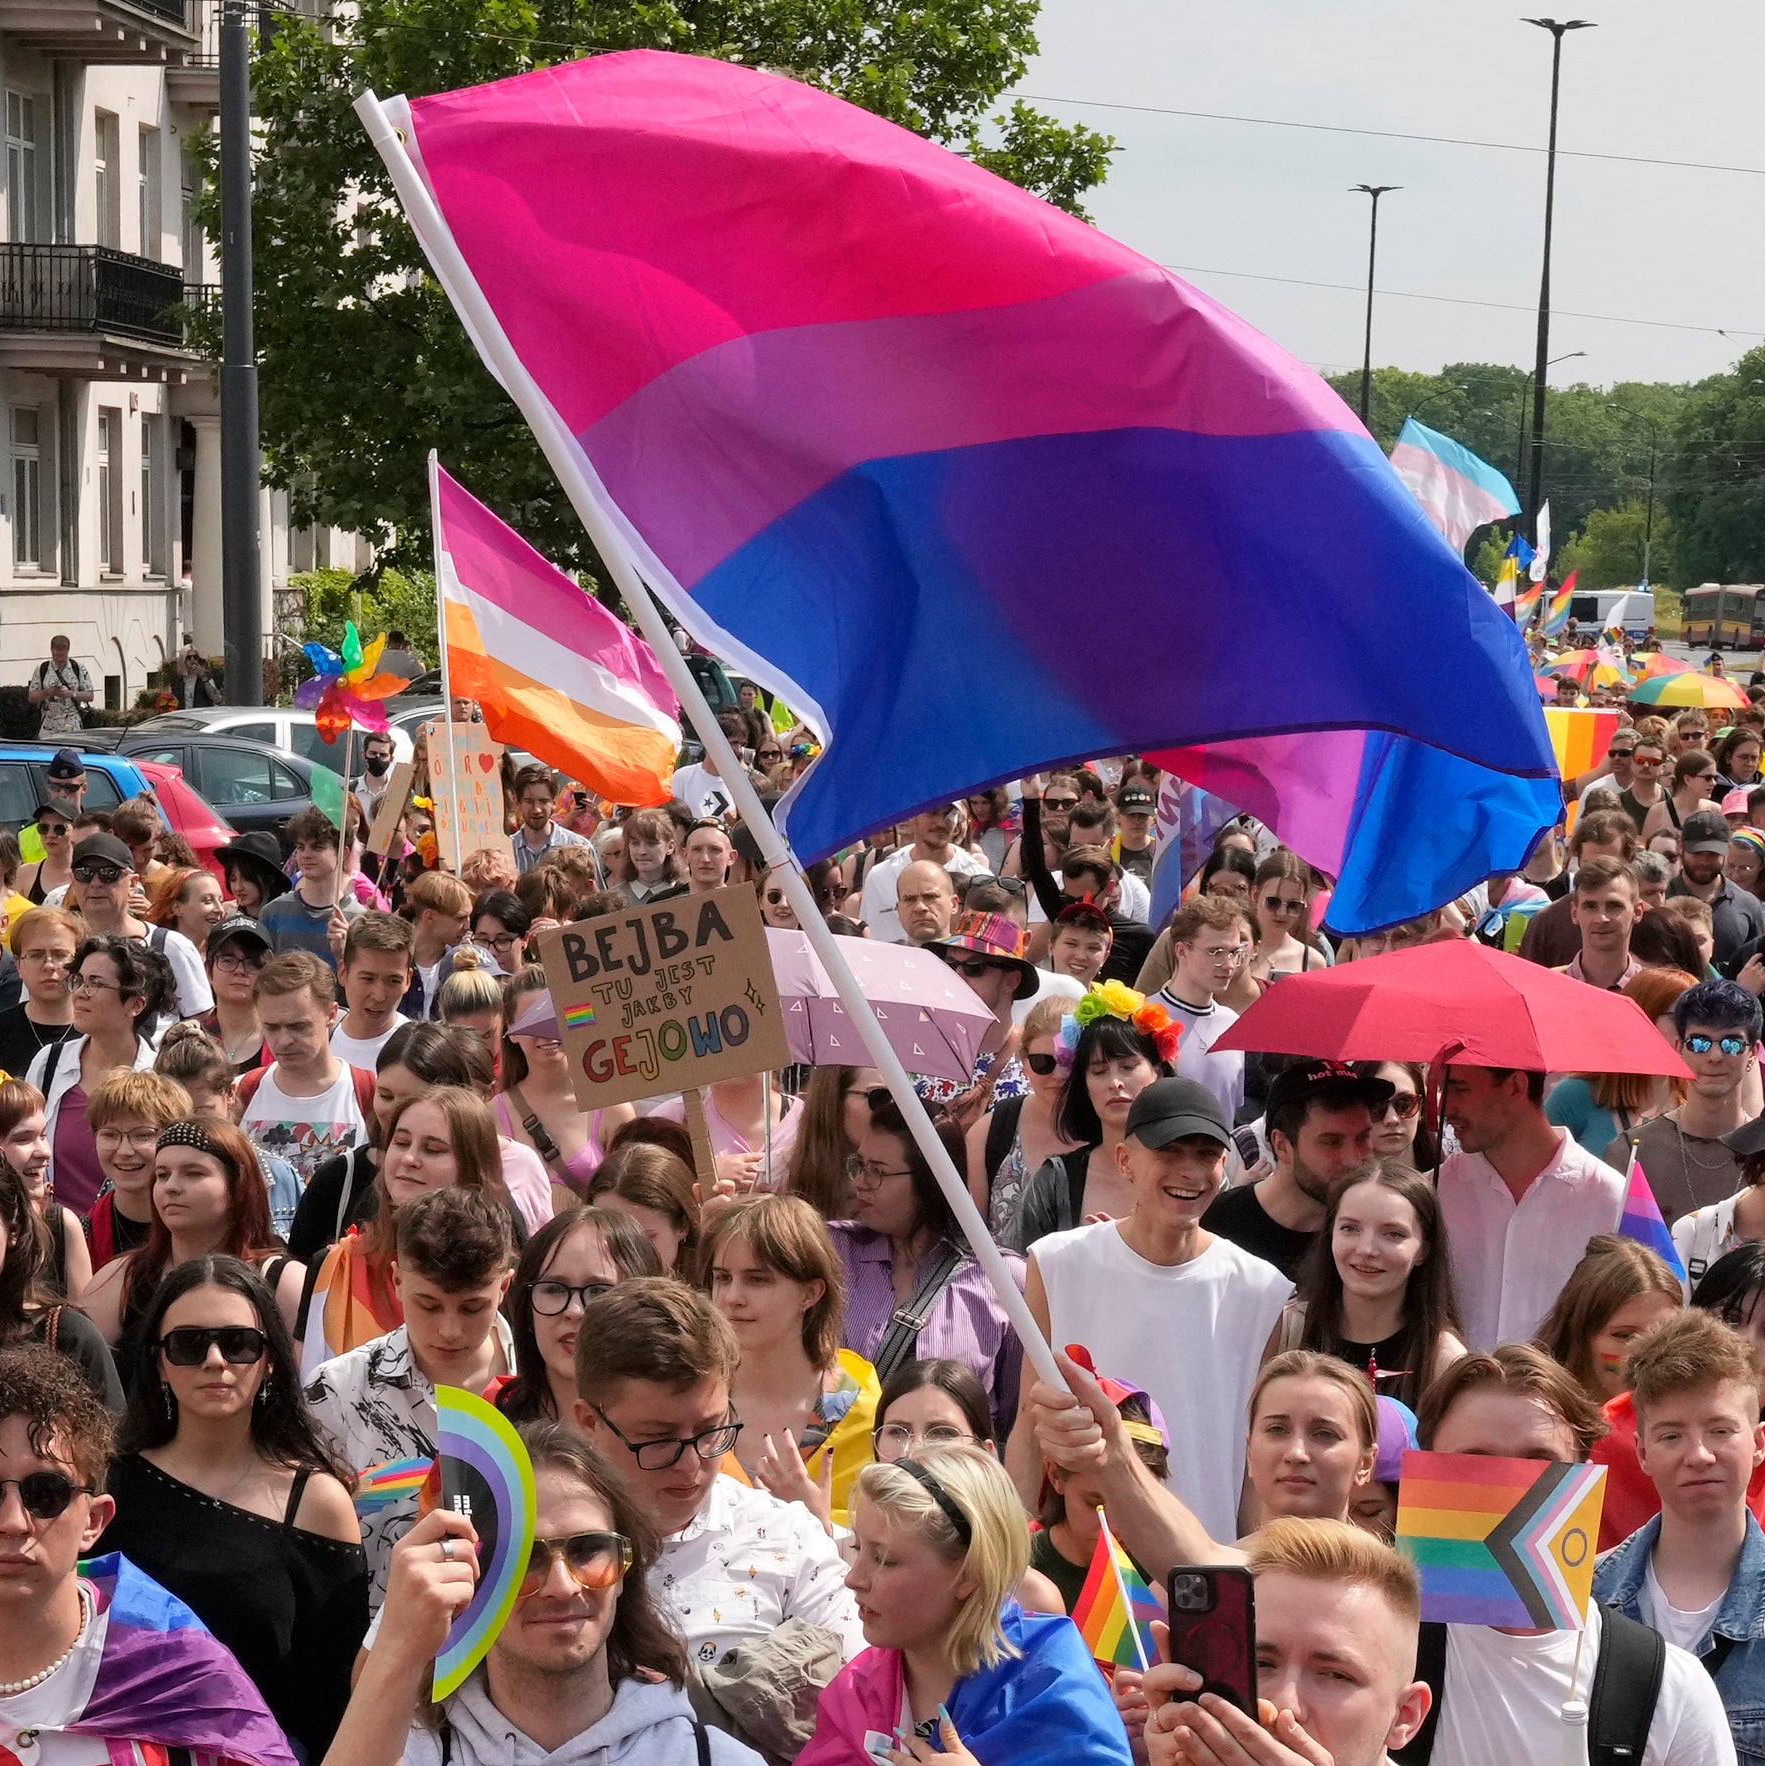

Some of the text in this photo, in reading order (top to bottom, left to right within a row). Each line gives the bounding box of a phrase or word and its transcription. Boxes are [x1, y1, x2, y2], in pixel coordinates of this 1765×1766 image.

[560, 900, 735, 984] BEJBA
[590, 954, 716, 1007] TU JEST
[620, 985, 694, 1029] JAKBY
[580, 1004, 750, 1085] GEJOWO
[1308, 1069, 1333, 1082] hot
